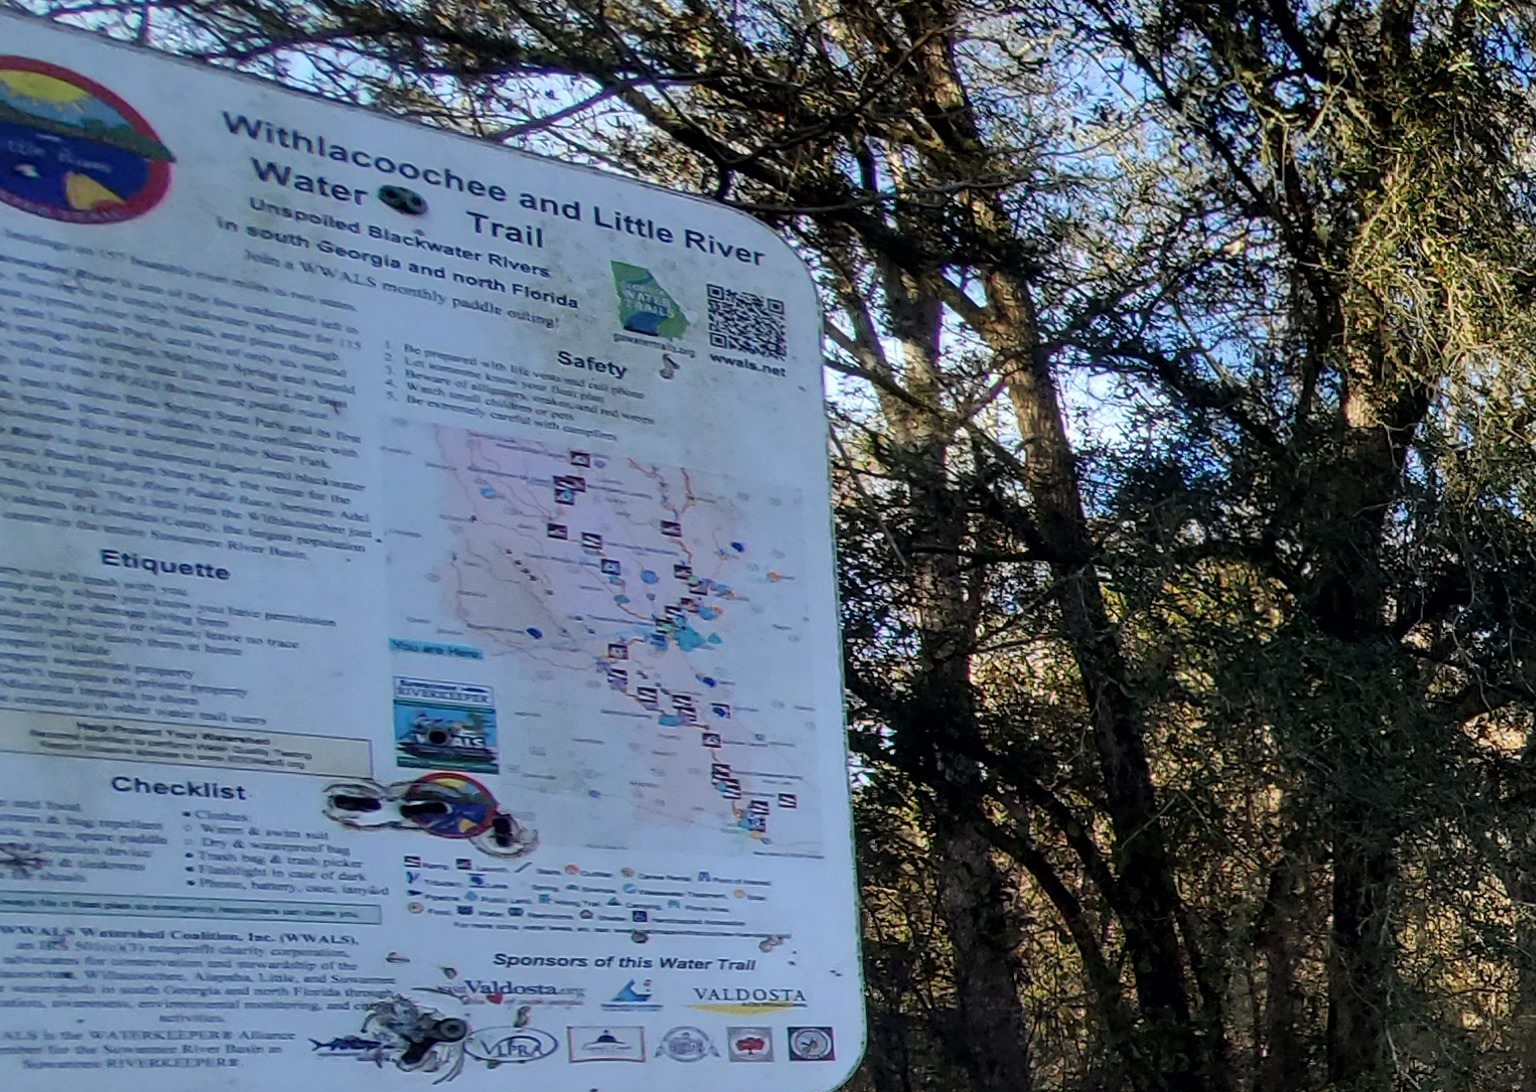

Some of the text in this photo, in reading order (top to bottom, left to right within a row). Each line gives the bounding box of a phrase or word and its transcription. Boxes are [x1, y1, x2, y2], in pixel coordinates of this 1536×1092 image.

[221, 110, 765, 266] Withlacoochee and Little River
[250, 157, 543, 248] Water Trail
[249, 196, 551, 279] Unspoiled Blackwater Rivers
[216, 215, 579, 309] in south Georgia and north Florida
[299, 261, 377, 289] WWALS
[381, 280, 447, 305] monthly
[452, 297, 504, 319] paddle
[557, 351, 628, 379] Safety
[708, 352, 786, 377] wwals.net
[100, 548, 231, 582] Etiquette
[111, 775, 248, 801] Checklist
[493, 952, 757, 972] Sponsors of this Water Trail
[693, 987, 807, 1003] VALDOSTA
